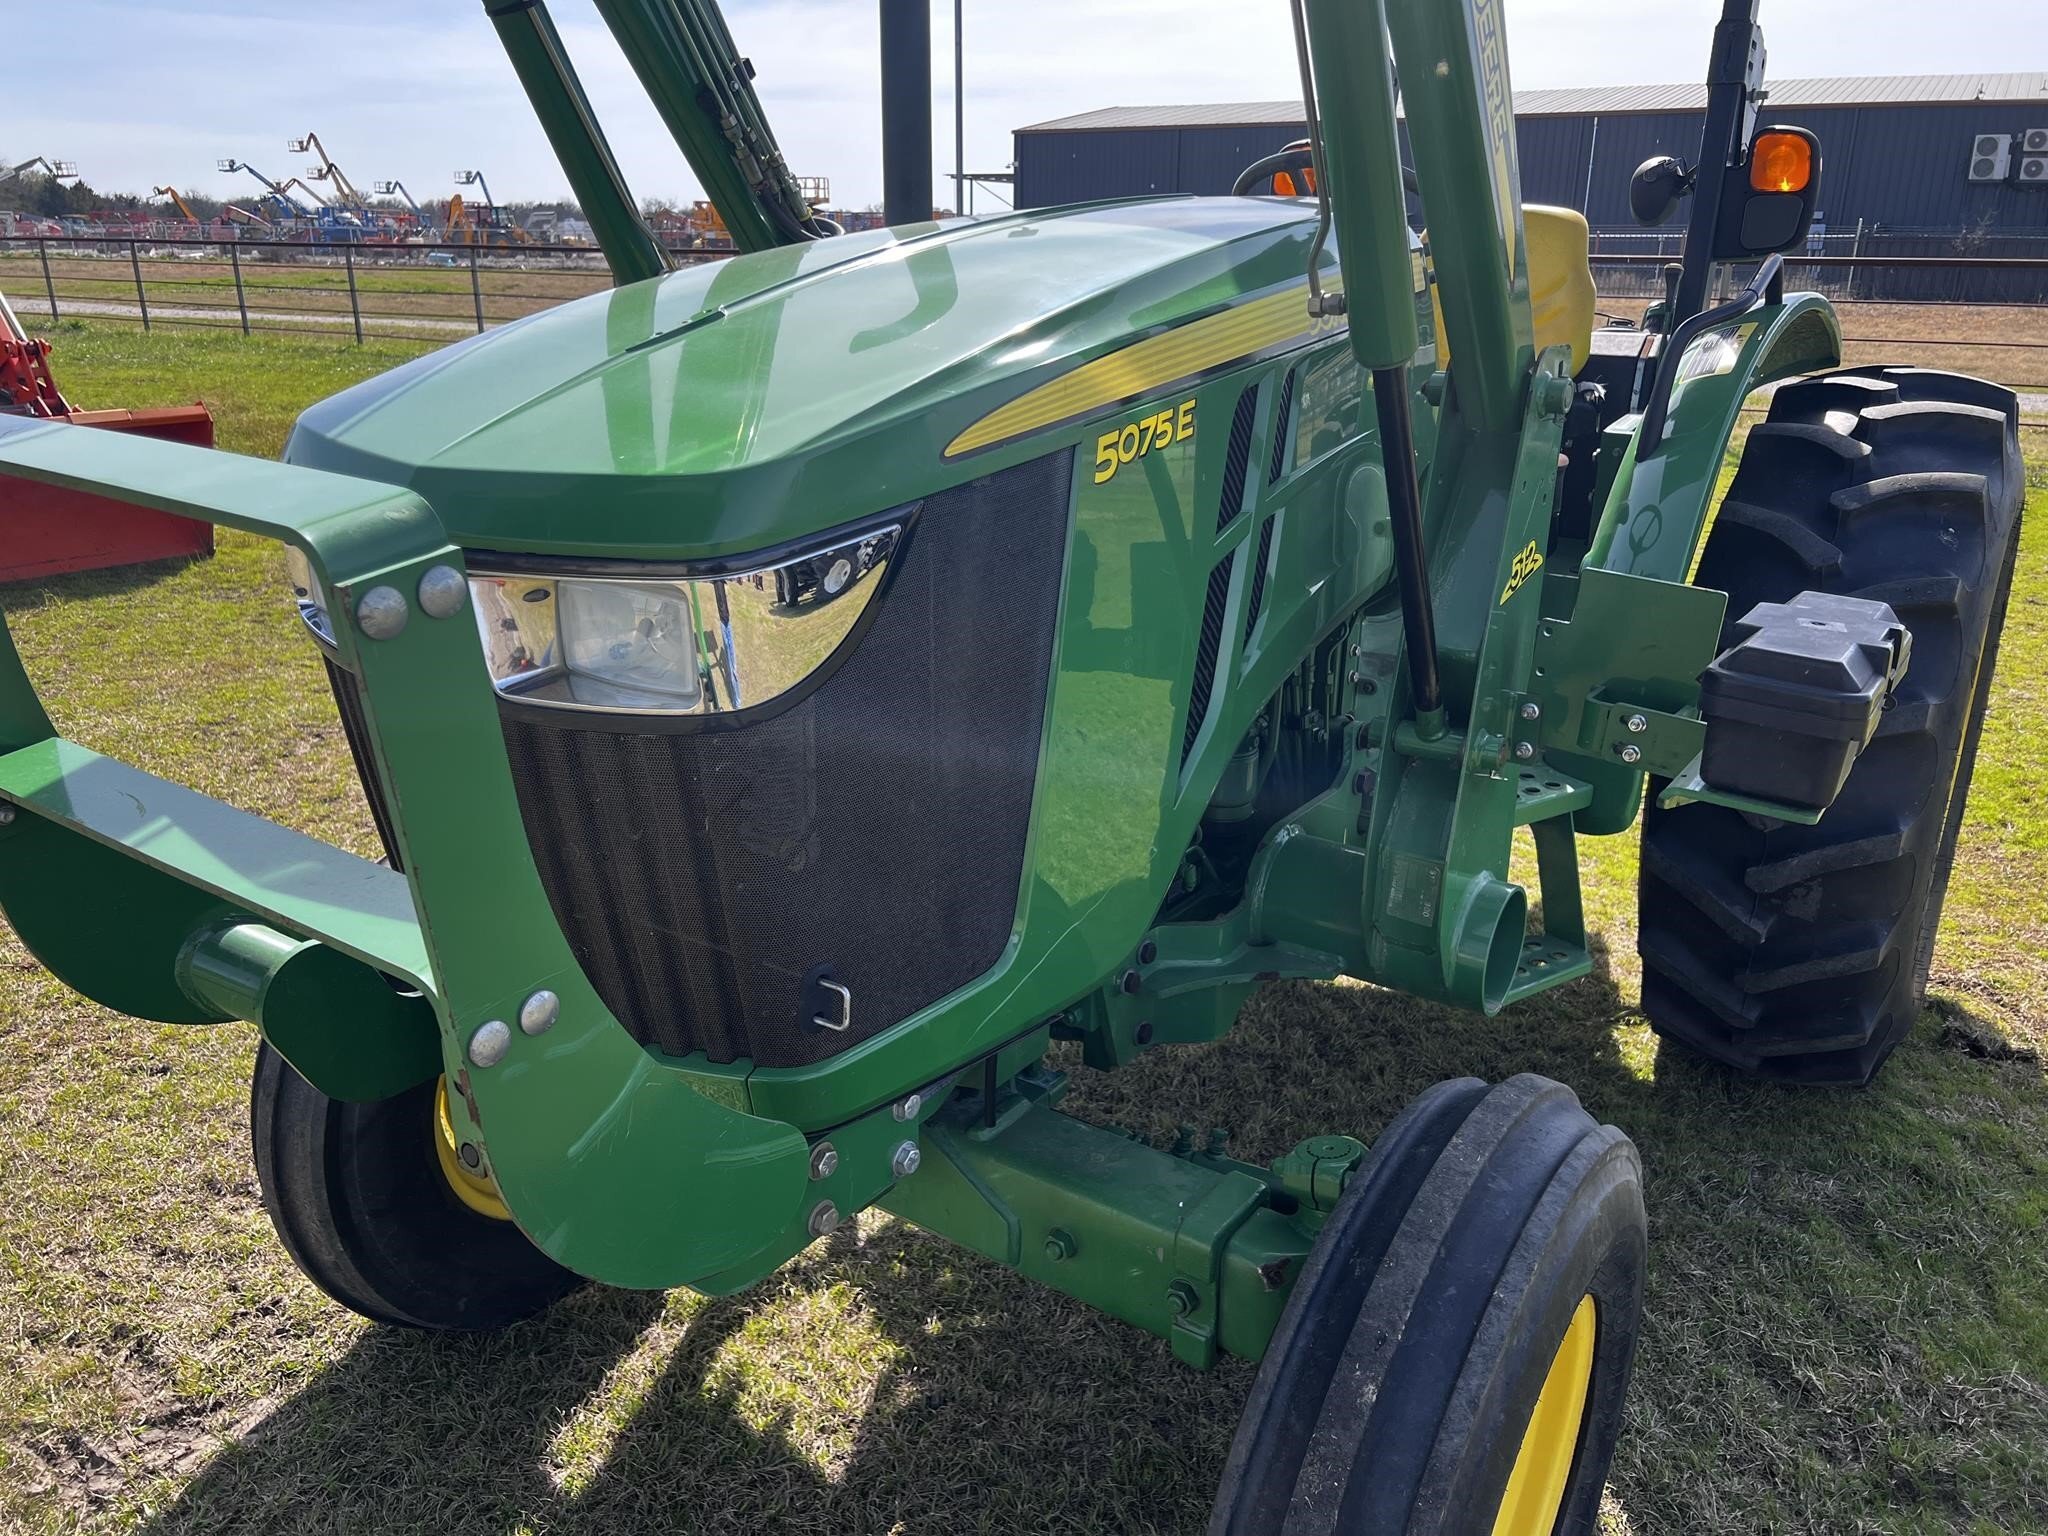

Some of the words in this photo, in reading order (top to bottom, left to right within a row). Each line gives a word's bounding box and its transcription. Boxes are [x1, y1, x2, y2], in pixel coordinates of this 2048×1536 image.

[1473, 0, 1507, 153] EERE
[1094, 398, 1197, 485] 5075E
[1509, 540, 1540, 591] 512
